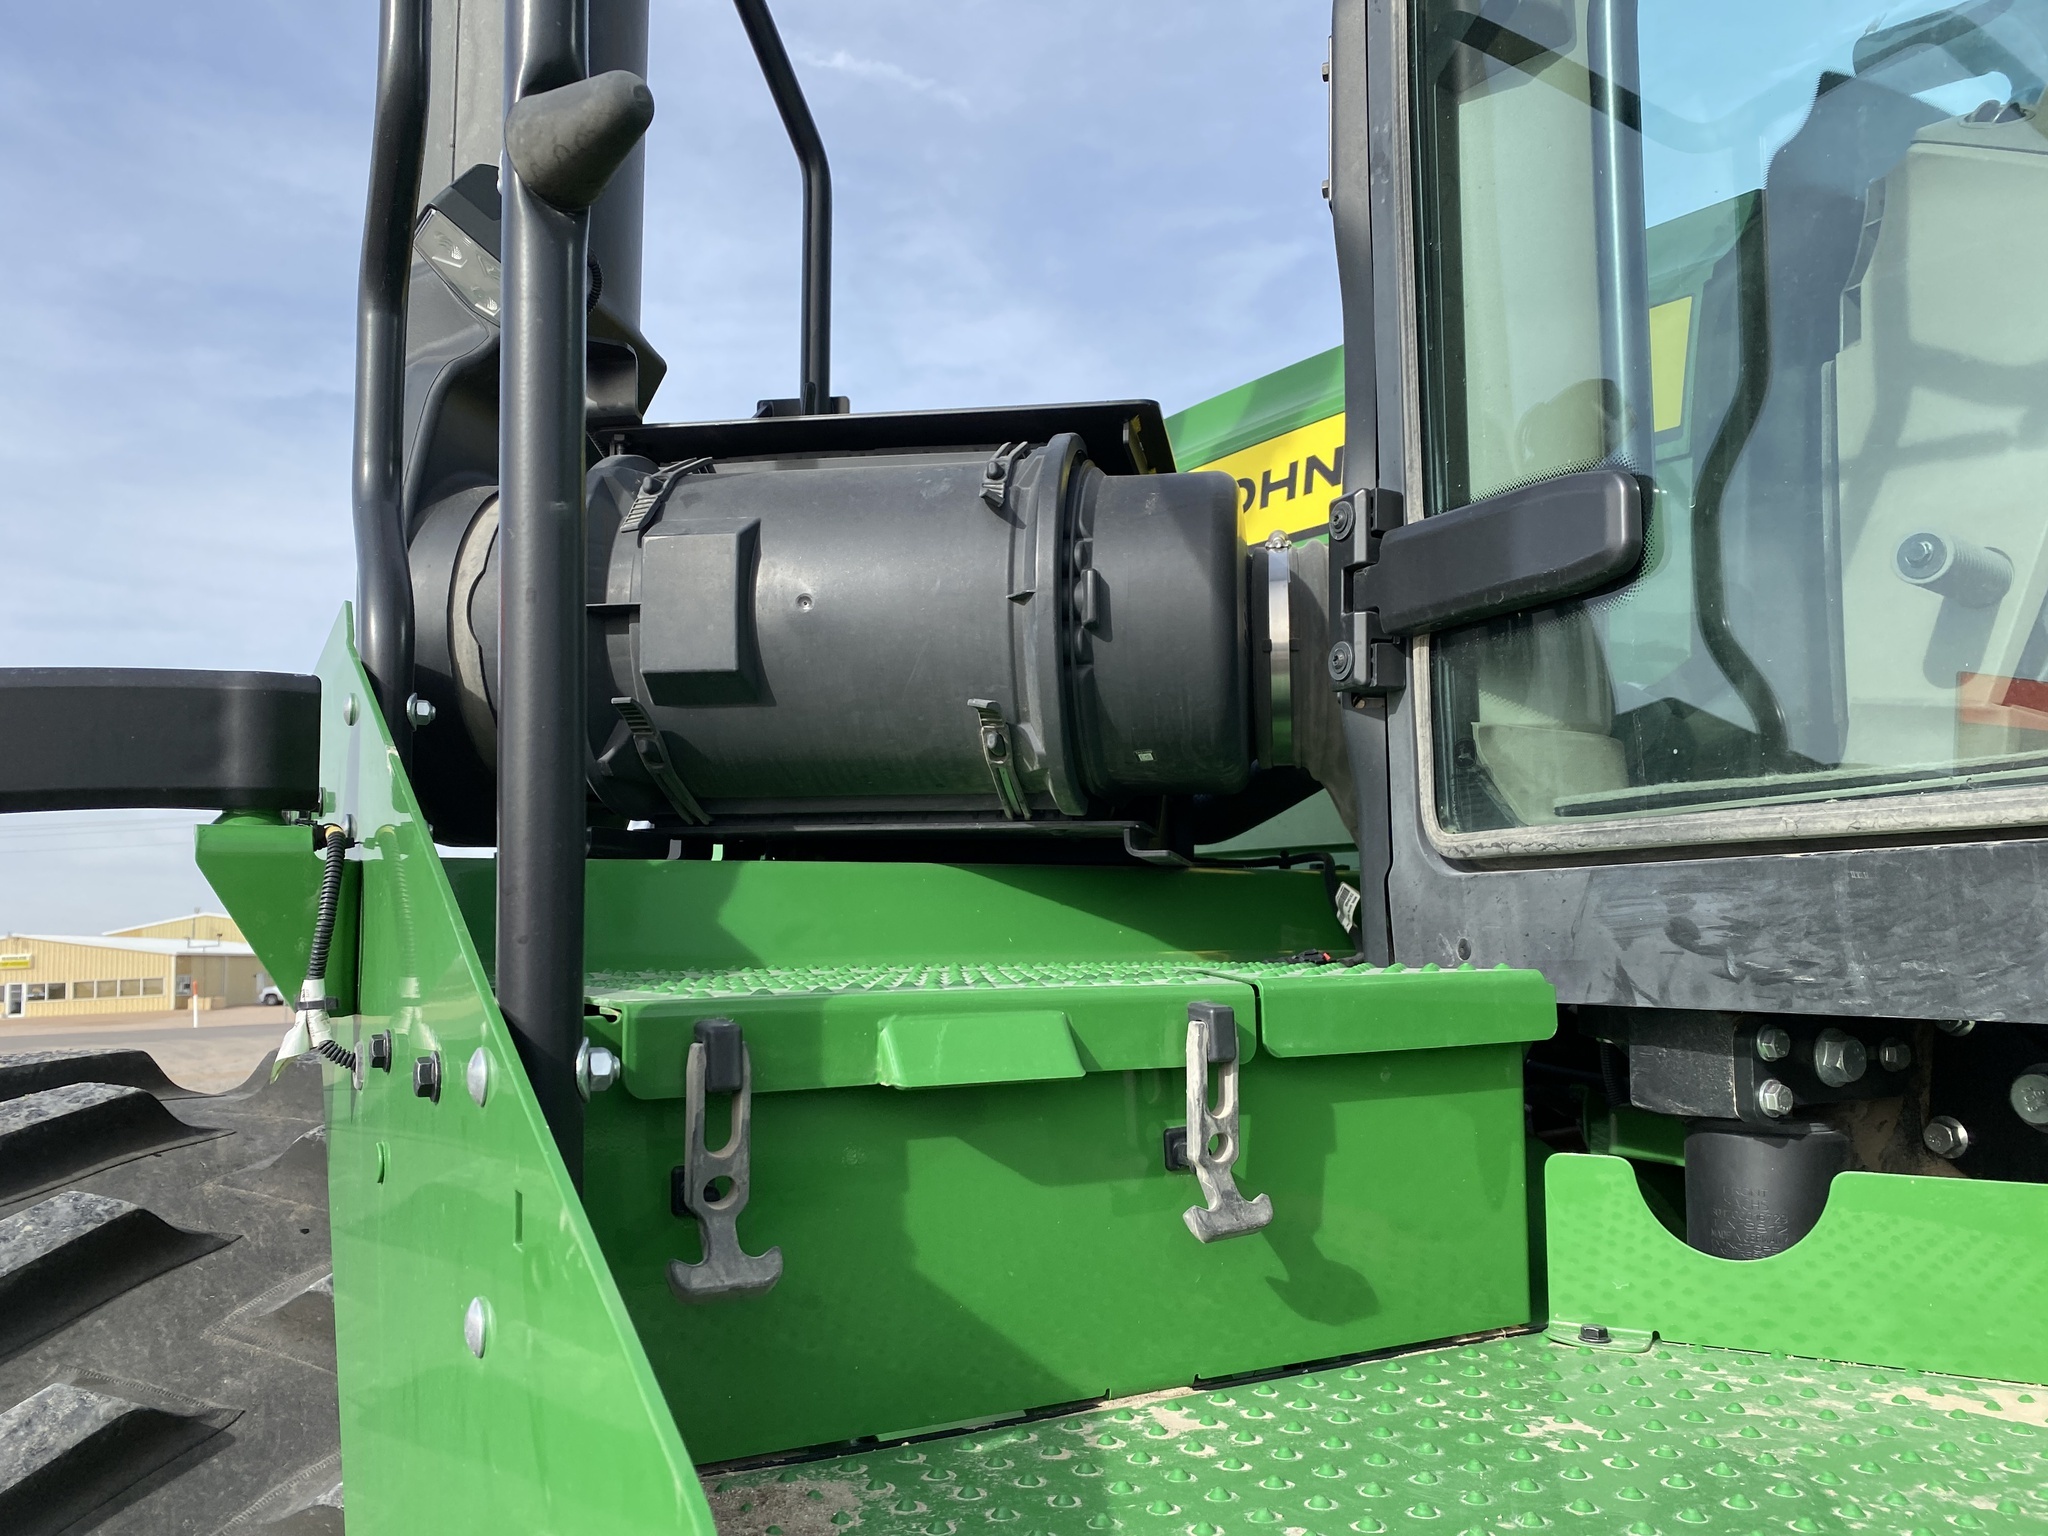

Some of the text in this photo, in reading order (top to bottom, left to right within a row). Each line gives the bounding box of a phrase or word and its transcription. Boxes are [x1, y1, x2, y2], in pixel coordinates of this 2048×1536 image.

[1722, 1185, 1769, 1197] FRONT
[1722, 1198, 1770, 1212] SACHS
[1743, 1233, 1789, 1247] GERMANY
